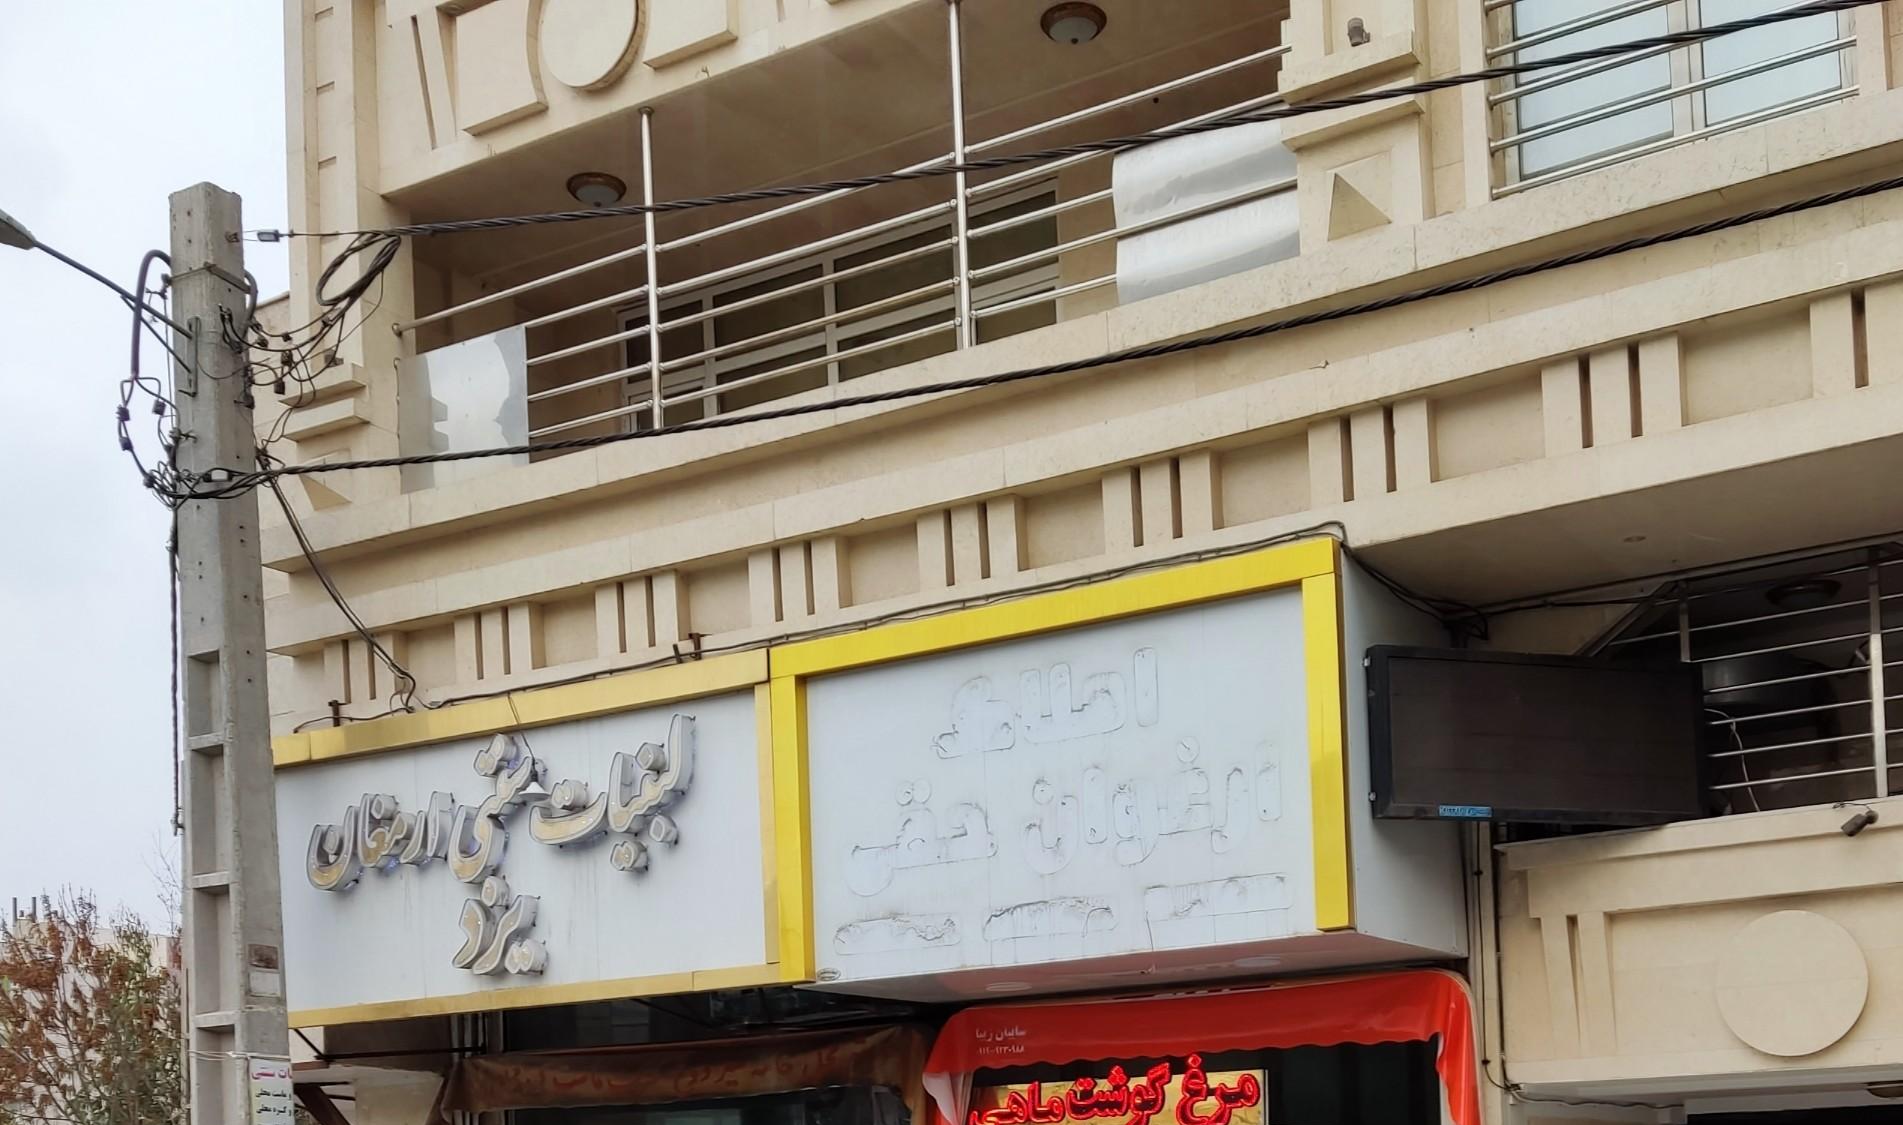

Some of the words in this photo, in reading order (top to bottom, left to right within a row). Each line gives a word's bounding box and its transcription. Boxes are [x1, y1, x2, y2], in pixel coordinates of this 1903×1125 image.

[306, 790, 454, 892] ارمغان
[449, 733, 546, 884] سنتی
[528, 713, 697, 872] لبنیات
[451, 874, 548, 977] یزد
